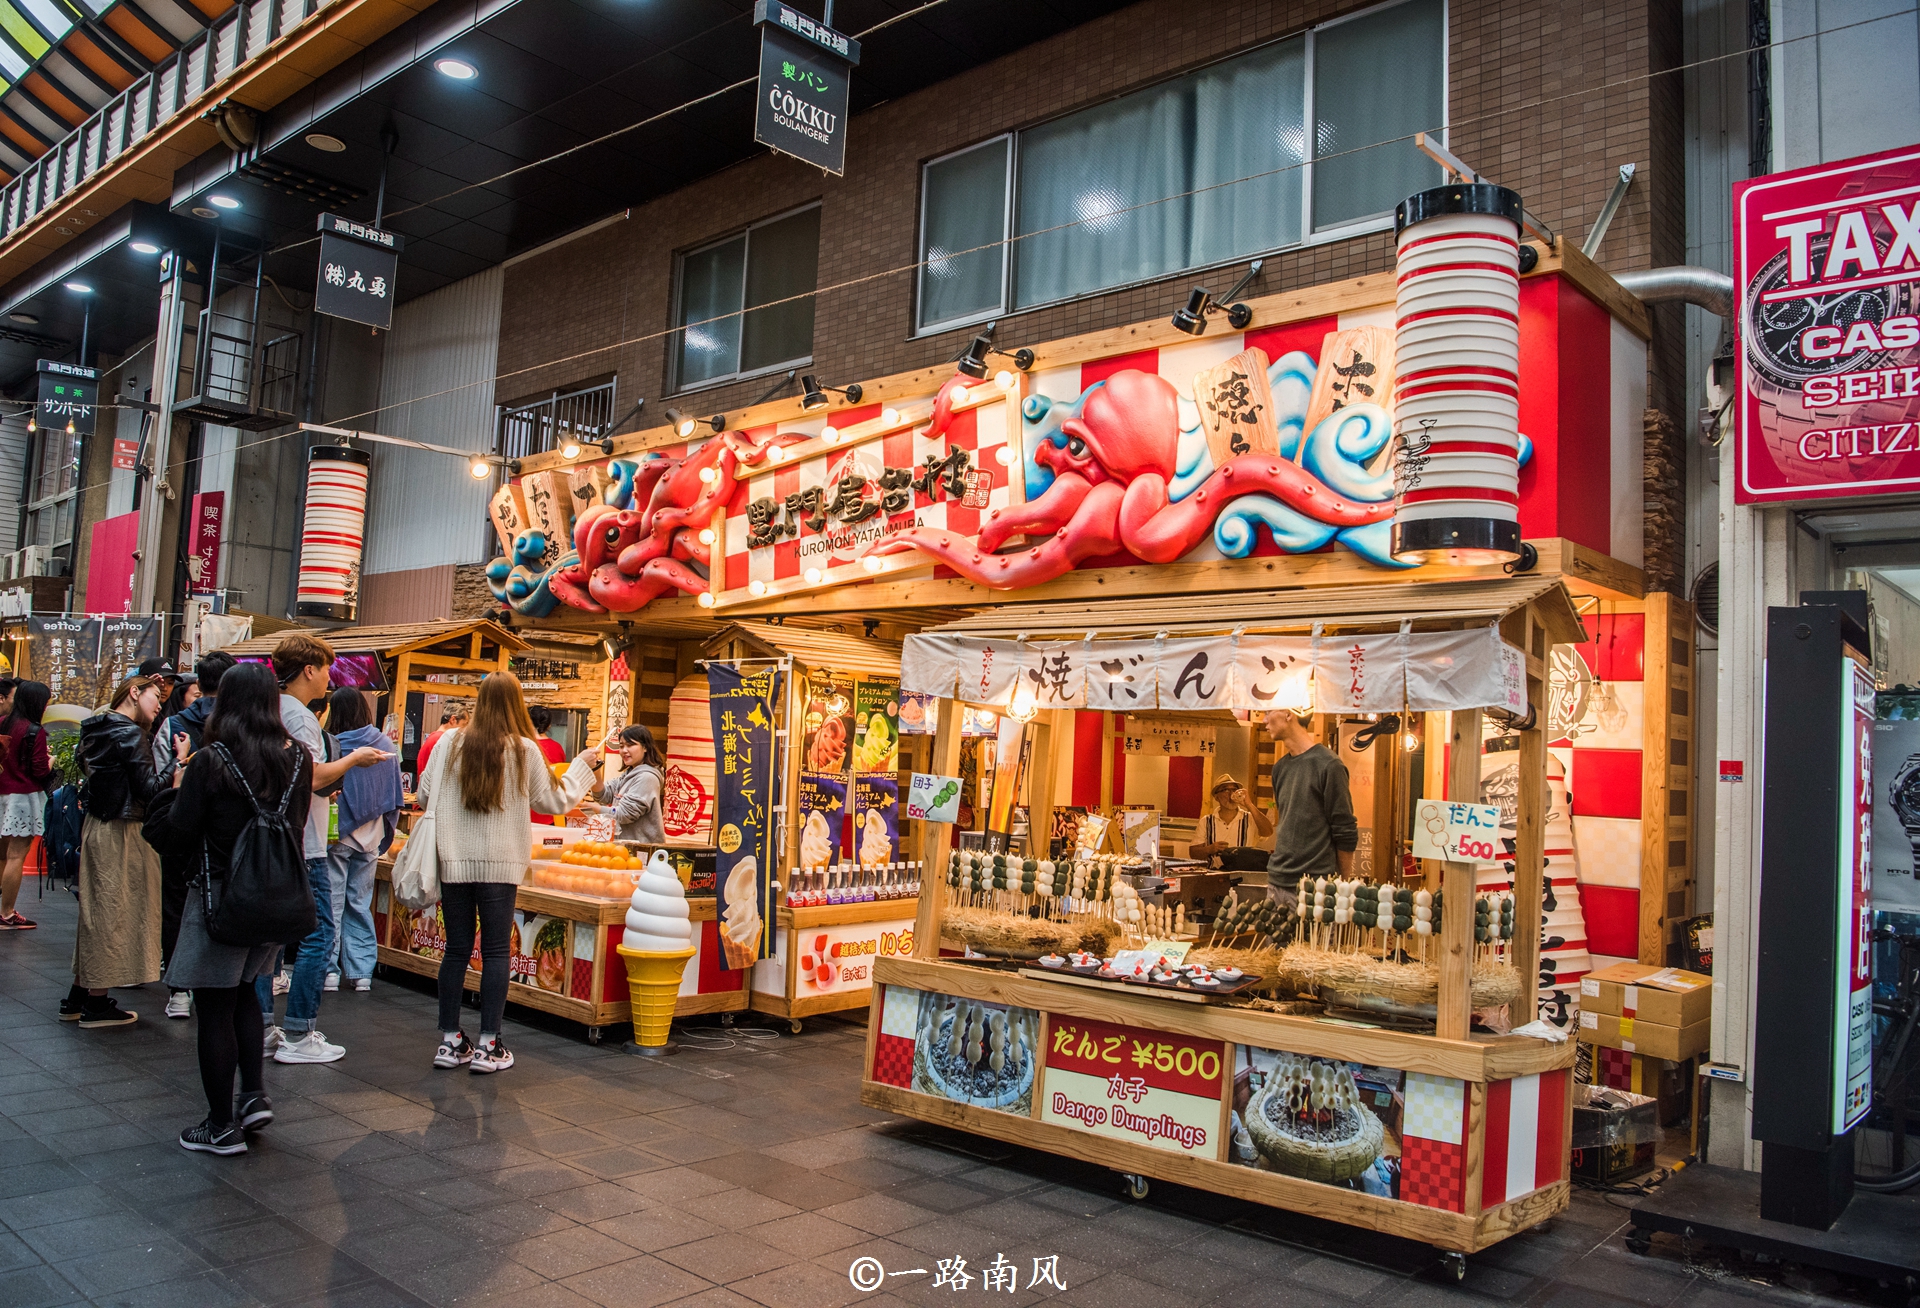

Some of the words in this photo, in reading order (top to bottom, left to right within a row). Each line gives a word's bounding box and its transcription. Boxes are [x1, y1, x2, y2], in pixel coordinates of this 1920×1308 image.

[779, 8, 849, 56] 黒門市場
[781, 61, 829, 93] 製パン
[773, 112, 830, 145] BOULANGERIE
[334, 218, 394, 247] 黒門市場
[1774, 200, 1920, 284] TAX
[47, 362, 96, 379] 黒門市場
[1799, 422, 1920, 461] CITIZ
[202, 505, 219, 539] 喫茶
[794, 533, 850, 558] KUROMON
[980, 646, 996, 700] 京だんご
[1028, 650, 1297, 703] 焼だんご
[1347, 644, 1367, 709] 京だんご
[856, 792, 881, 801] プレミアム
[913, 776, 934, 790] 団子
[1448, 803, 1500, 828] だんご
[1450, 834, 1494, 860] ¥500
[688, 872, 717, 891] Genesis
[414, 929, 432, 946] Kobe
[842, 966, 867, 981] 白大福
[1053, 1025, 1126, 1064] だんご
[1131, 1040, 1220, 1080] ¥500
[1107, 1072, 1148, 1104] 丸子
[1052, 1092, 1108, 1127] Dango
[1112, 1104, 1207, 1149] Dumplings
